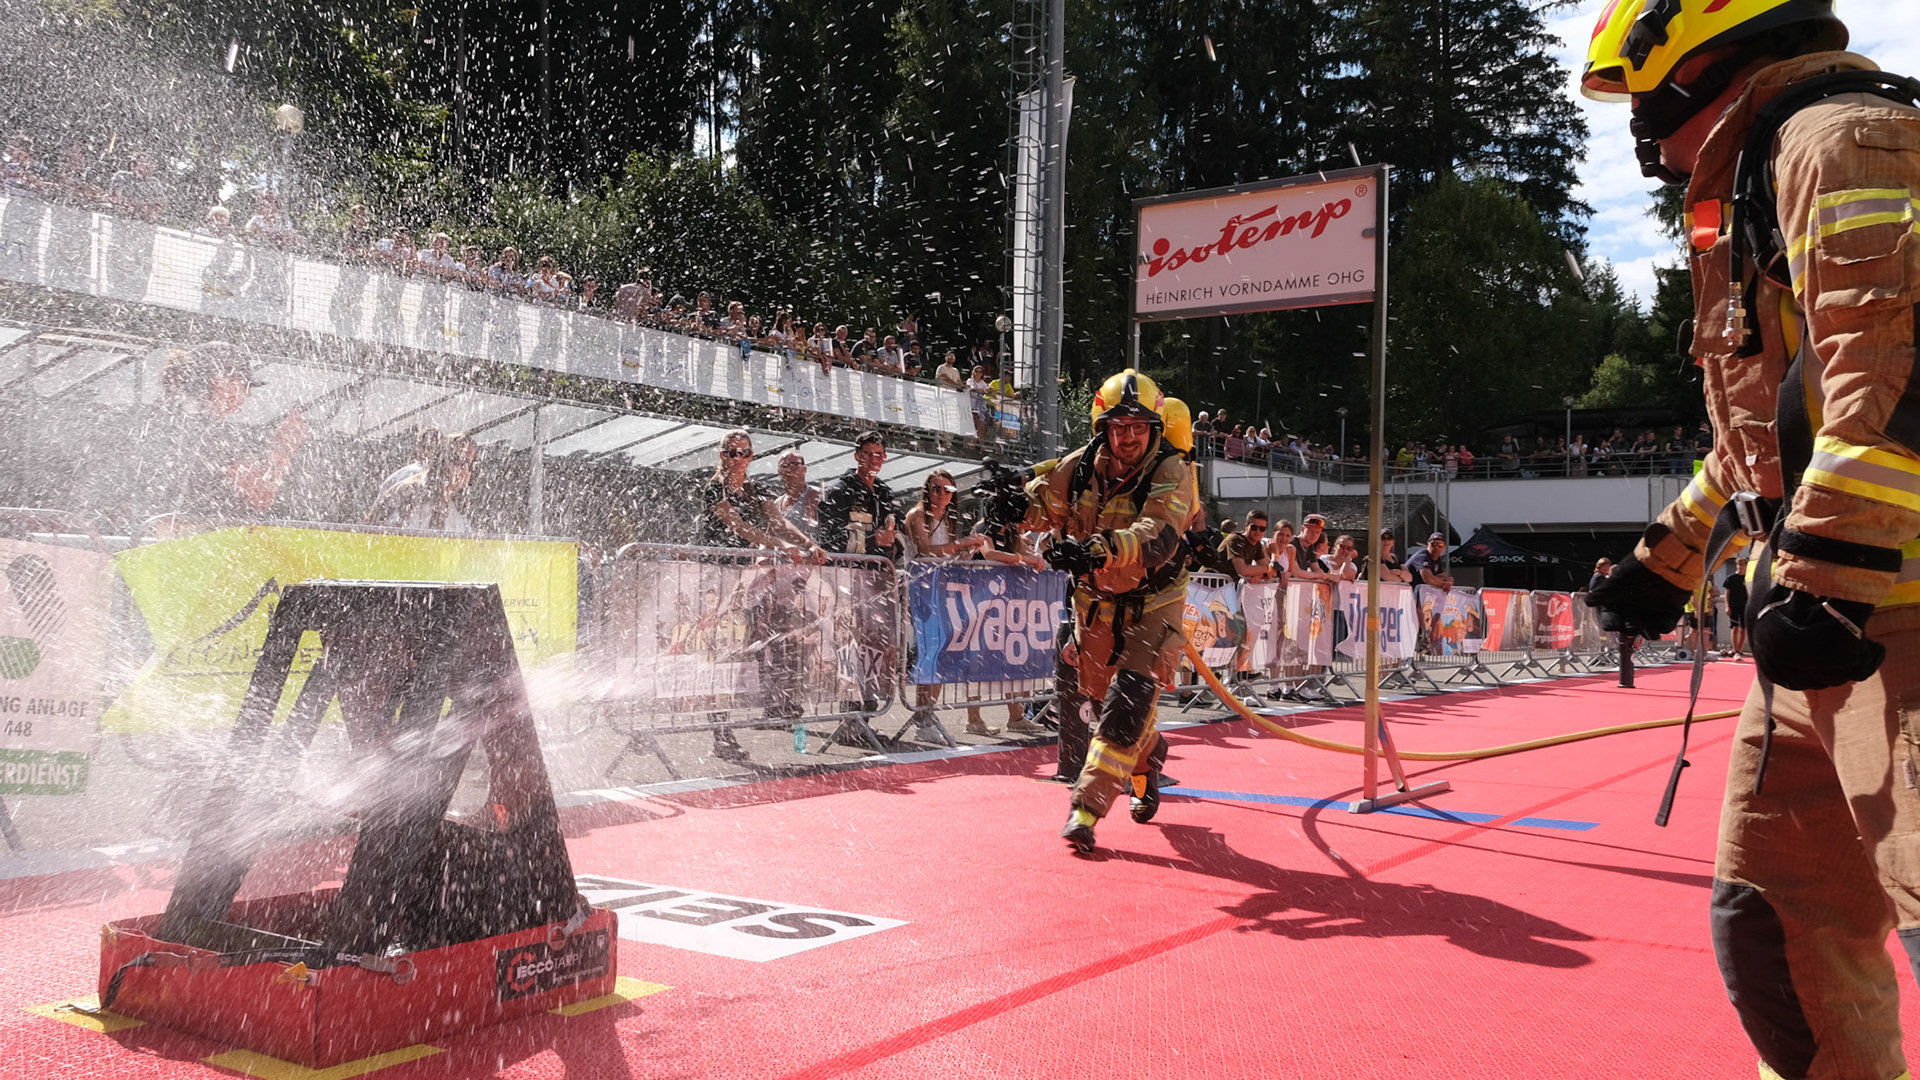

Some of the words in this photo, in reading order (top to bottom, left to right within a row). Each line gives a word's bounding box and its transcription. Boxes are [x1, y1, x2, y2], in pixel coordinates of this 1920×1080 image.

[1148, 198, 1352, 277] isotemp
[1146, 286, 1213, 305] HEINRICH
[1219, 274, 1320, 297] VORNDAMME
[1327, 269, 1365, 285] OHG
[1488, 555, 1526, 563] 24MX
[946, 580, 1065, 665] Dräger
[1349, 593, 1404, 652] Drger
[26, 698, 88, 717] ANLAGE
